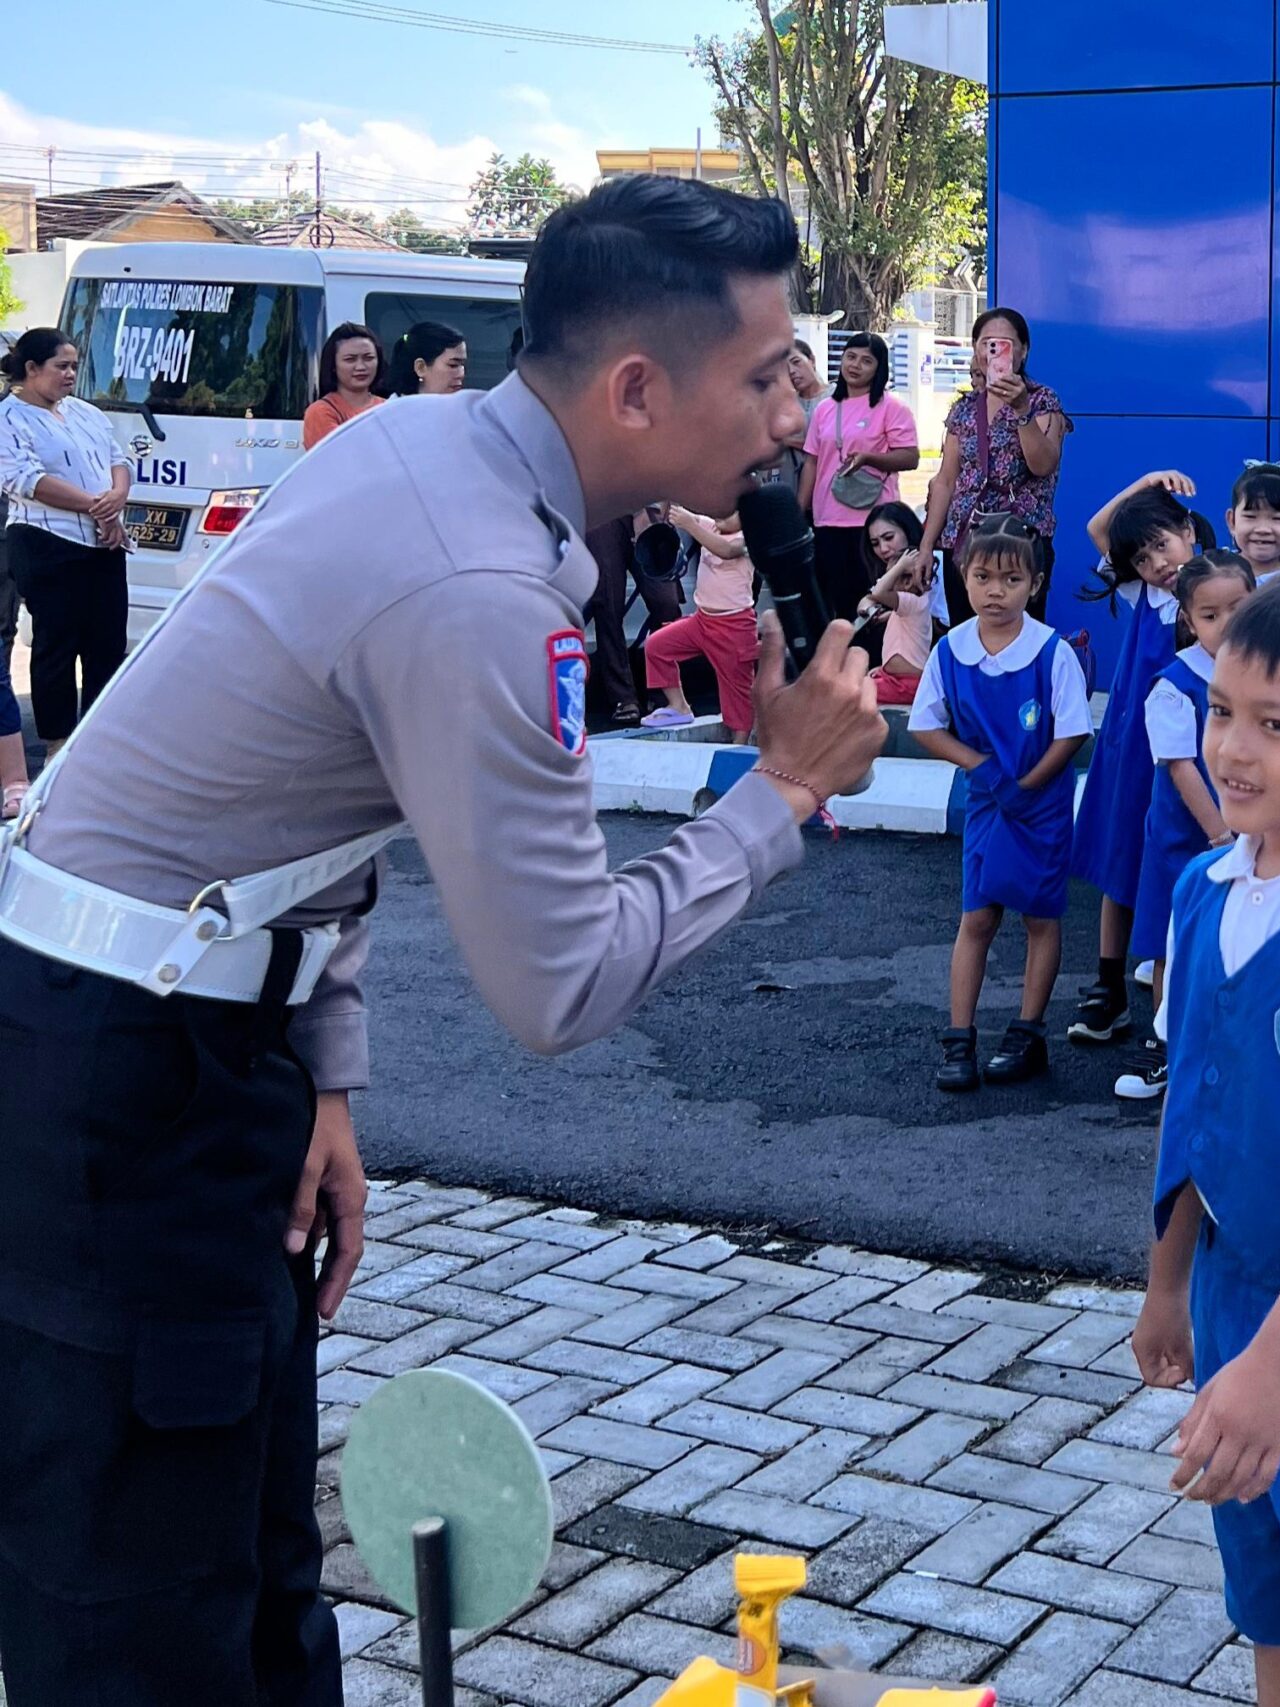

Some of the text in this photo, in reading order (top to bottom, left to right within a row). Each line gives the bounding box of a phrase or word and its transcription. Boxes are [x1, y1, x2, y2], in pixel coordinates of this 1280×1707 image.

[101, 282, 234, 313] SATLANTAS POLRES LOMBOK BARAT
[113, 325, 195, 384] BRZ-9401
[130, 457, 187, 486] LISI
